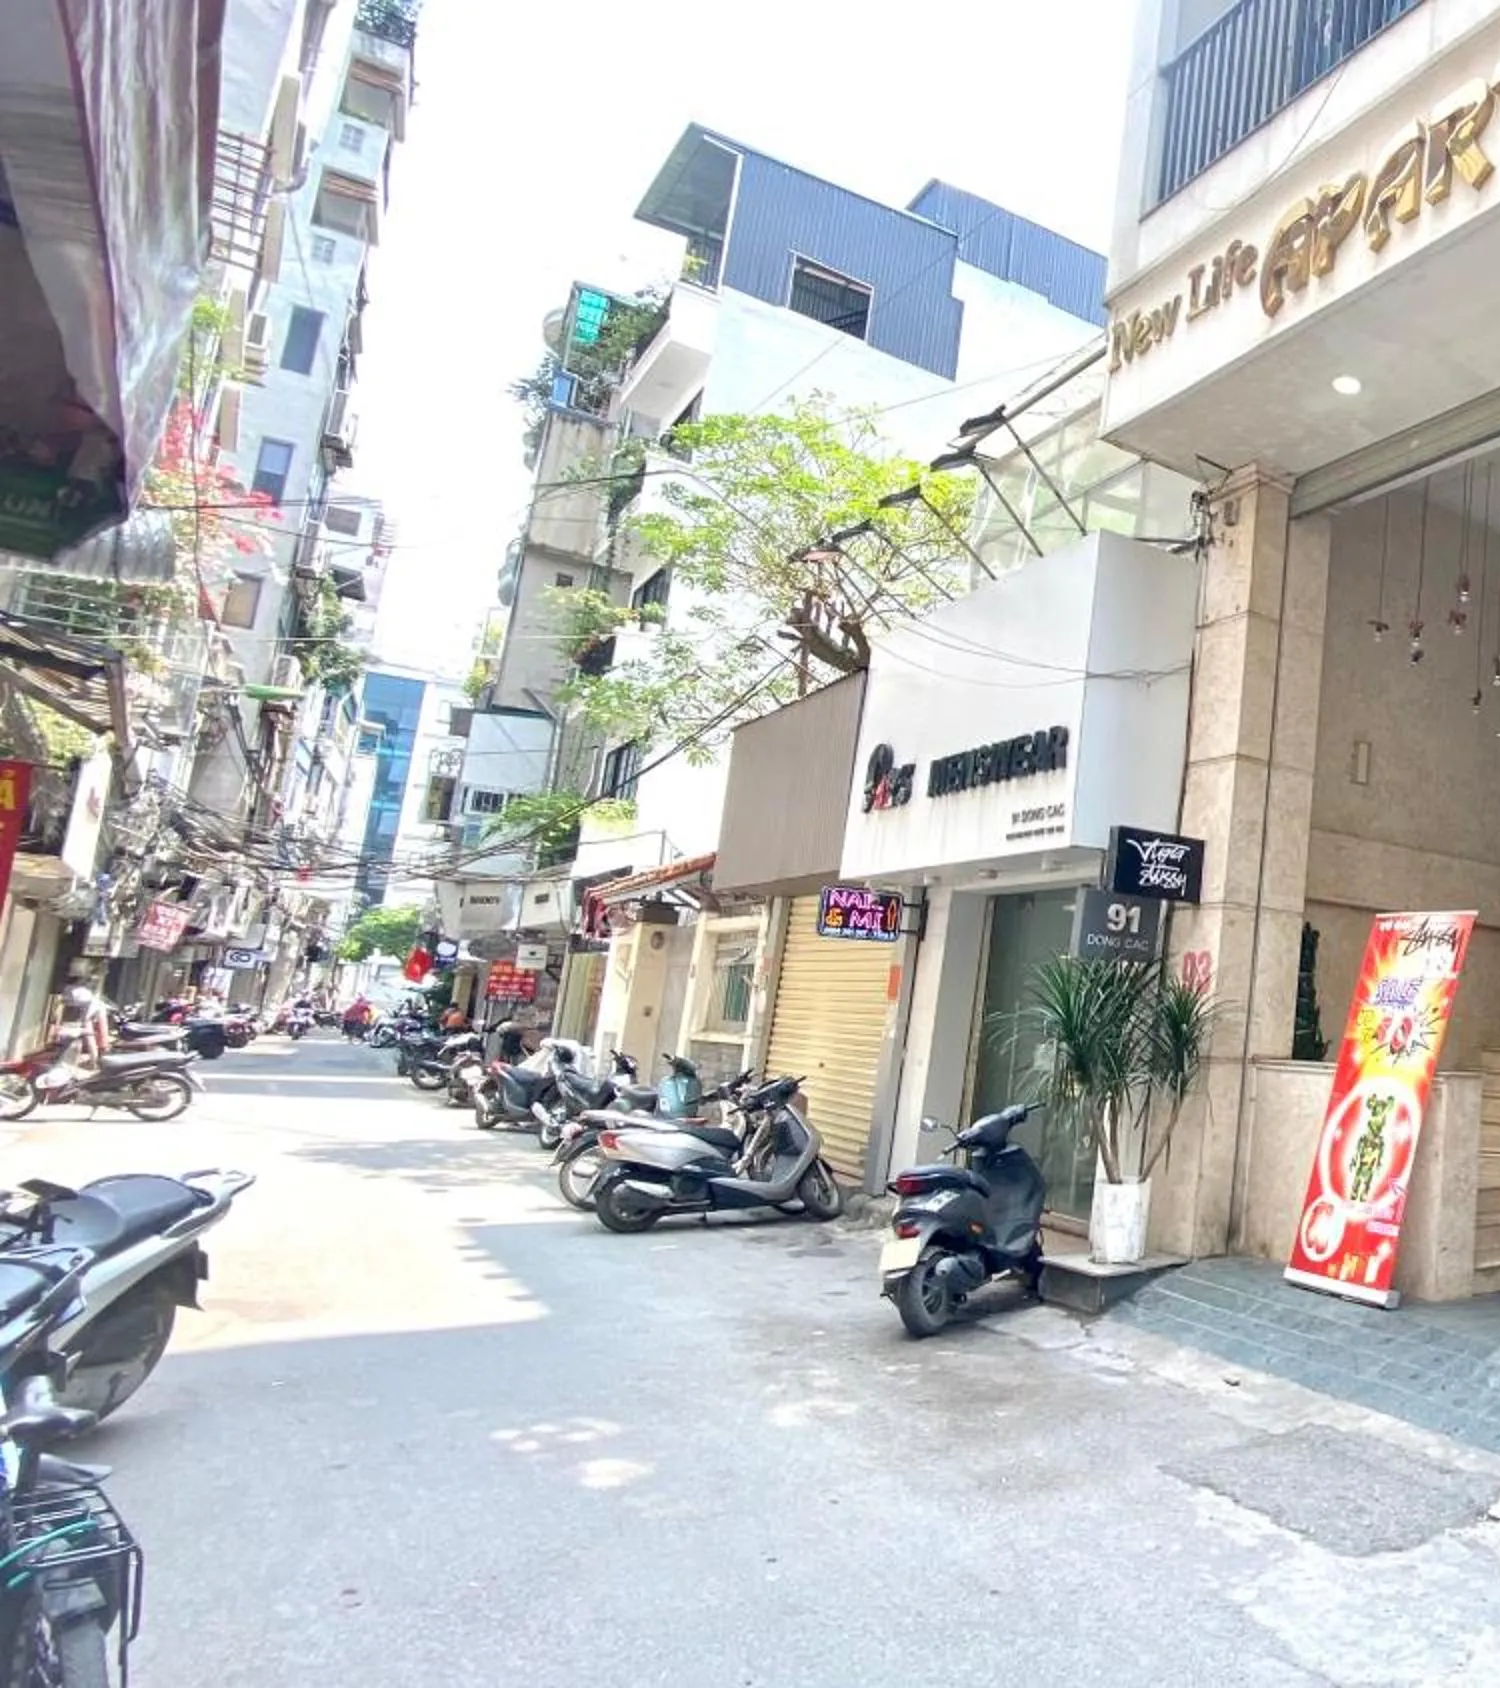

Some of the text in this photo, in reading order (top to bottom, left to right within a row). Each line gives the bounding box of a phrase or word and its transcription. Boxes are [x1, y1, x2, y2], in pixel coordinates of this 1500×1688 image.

[1108, 294, 1182, 375] New
[1186, 239, 1258, 322] Life
[1107, 903, 1141, 933] 91
